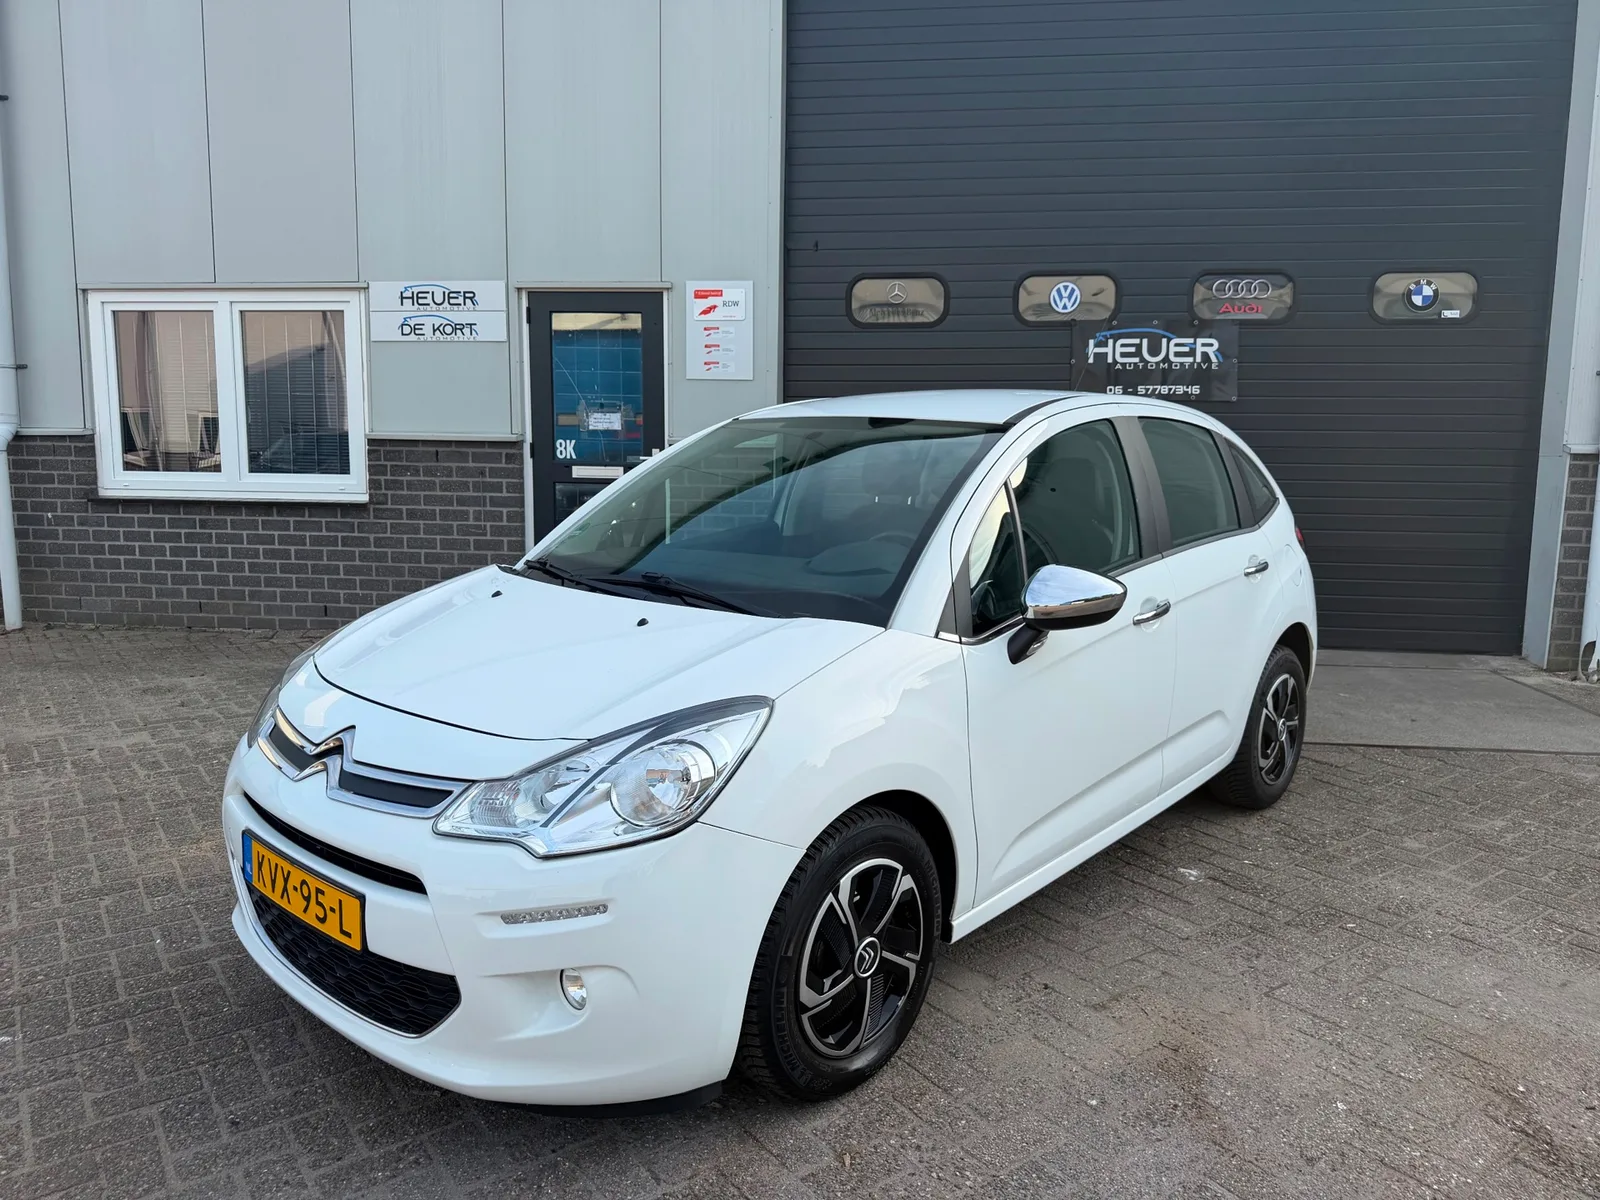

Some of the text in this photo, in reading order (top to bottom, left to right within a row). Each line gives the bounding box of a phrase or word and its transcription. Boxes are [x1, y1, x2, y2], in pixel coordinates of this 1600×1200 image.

[1409, 279, 1437, 291] BMW
[400, 290, 477, 306] HEUER
[722, 300, 740, 308] RDW
[1219, 303, 1263, 313] Audi
[401, 323, 477, 336] DE KORT
[1087, 338, 1220, 364] HEUER
[1115, 362, 1219, 370] AUTOMOTIVE
[1106, 385, 1123, 395] 06
[1137, 385, 1200, 395] 57787346
[555, 439, 577, 460] 8K
[257, 850, 353, 940] KVX-95-L
